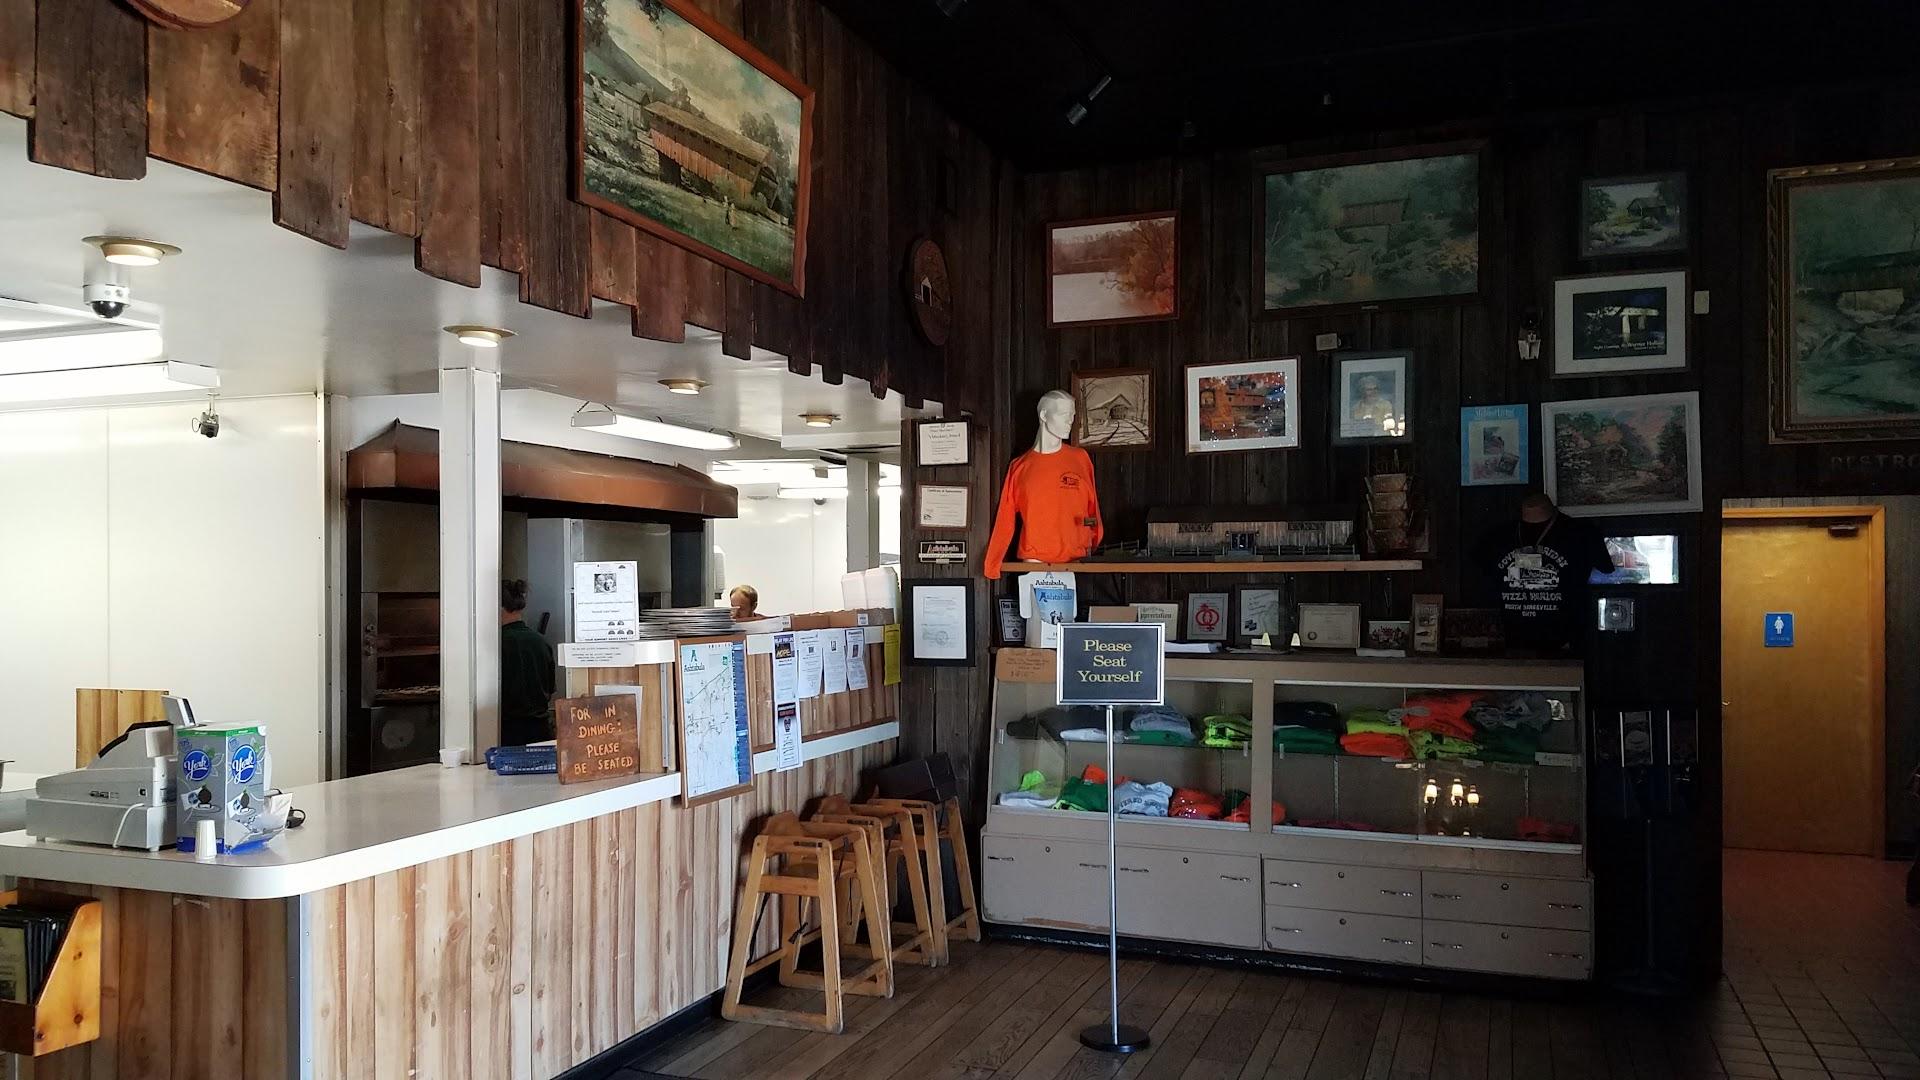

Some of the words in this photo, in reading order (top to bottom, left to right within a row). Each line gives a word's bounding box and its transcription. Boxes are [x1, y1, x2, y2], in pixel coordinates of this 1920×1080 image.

[1039, 592, 1073, 602] Ashtabula
[1083, 639, 1132, 652] Please
[1093, 655, 1127, 667] Seat
[1077, 670, 1143, 683] Yourself
[570, 707, 591, 723] FOR
[605, 704, 616, 718] IN
[586, 742, 620, 758] PLEASE
[232, 750, 254, 784] York
[574, 763, 587, 774] BE
[598, 756, 633, 770] SEATED
